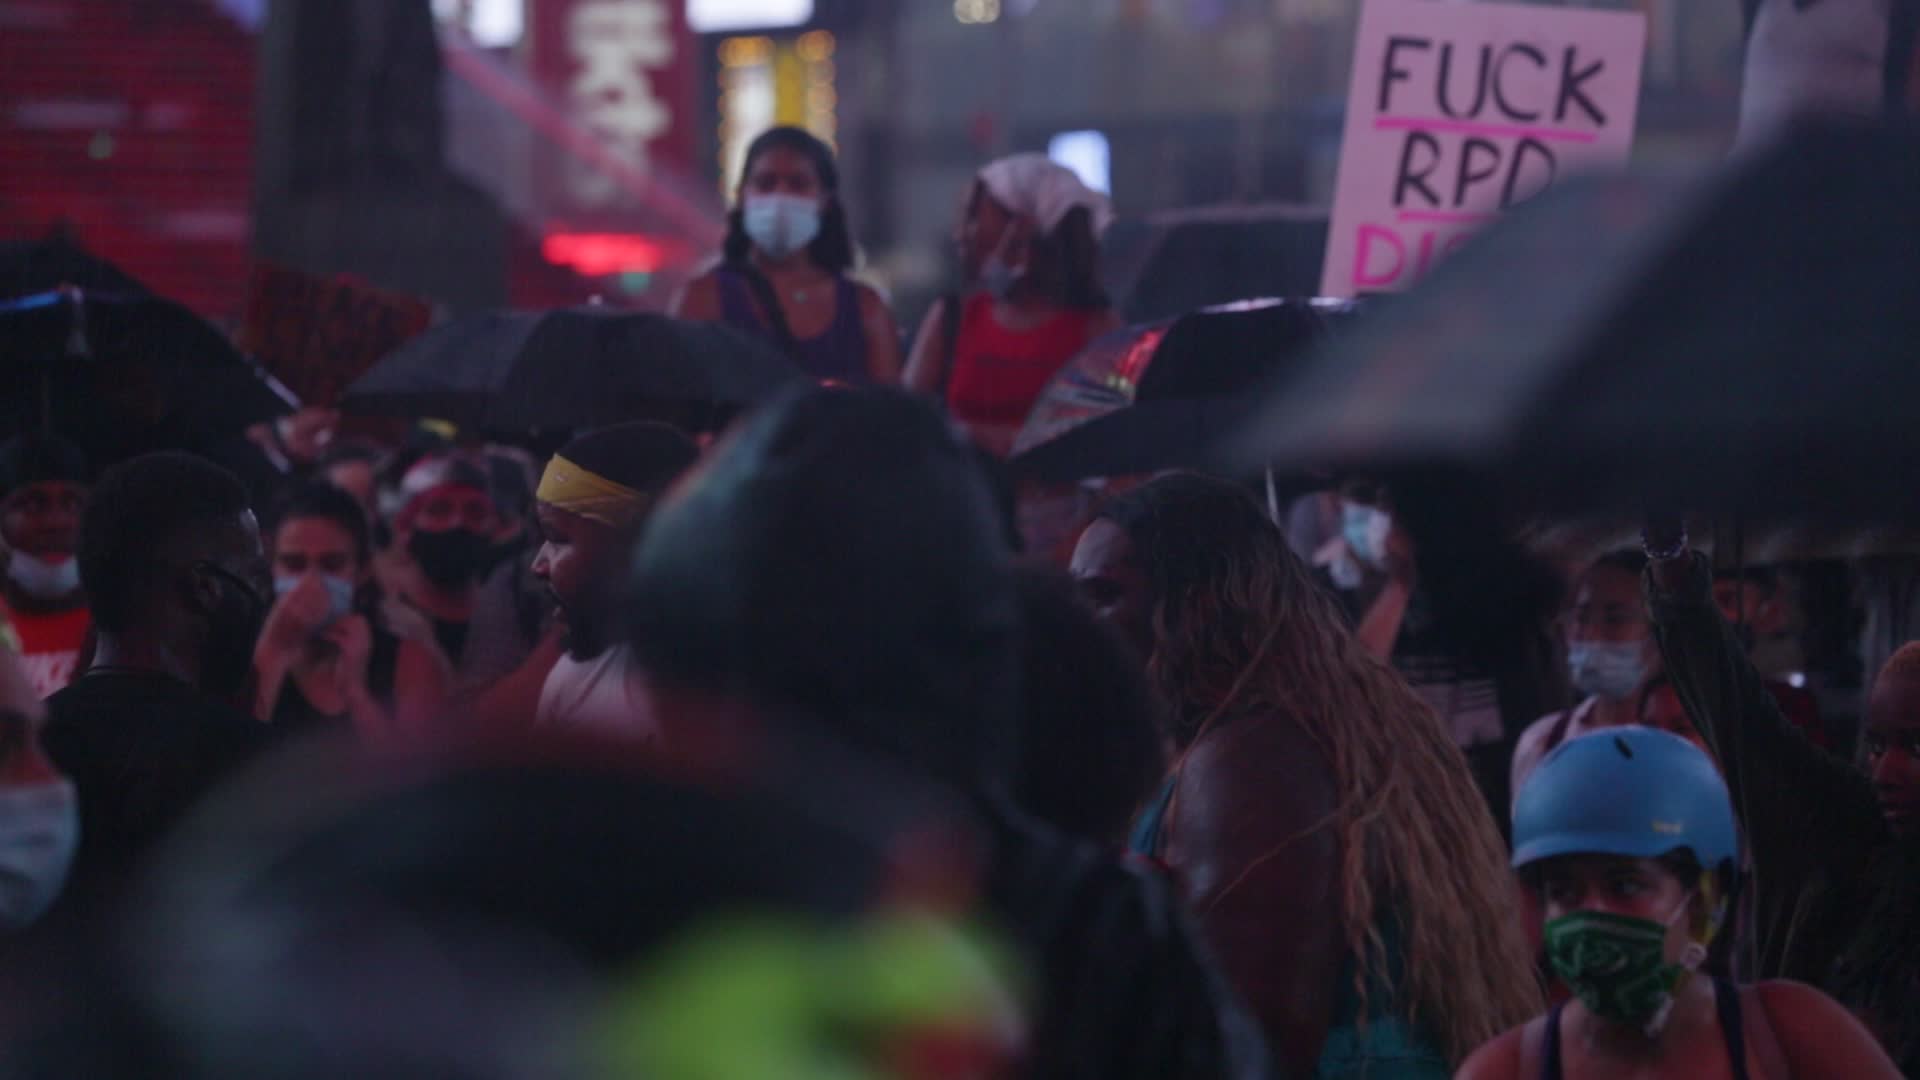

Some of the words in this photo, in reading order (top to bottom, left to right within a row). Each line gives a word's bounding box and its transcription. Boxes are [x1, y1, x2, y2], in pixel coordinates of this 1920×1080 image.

[1378, 35, 1606, 126] FUCK
[1394, 131, 1556, 207] RPD
[1354, 224, 1473, 287] DI
